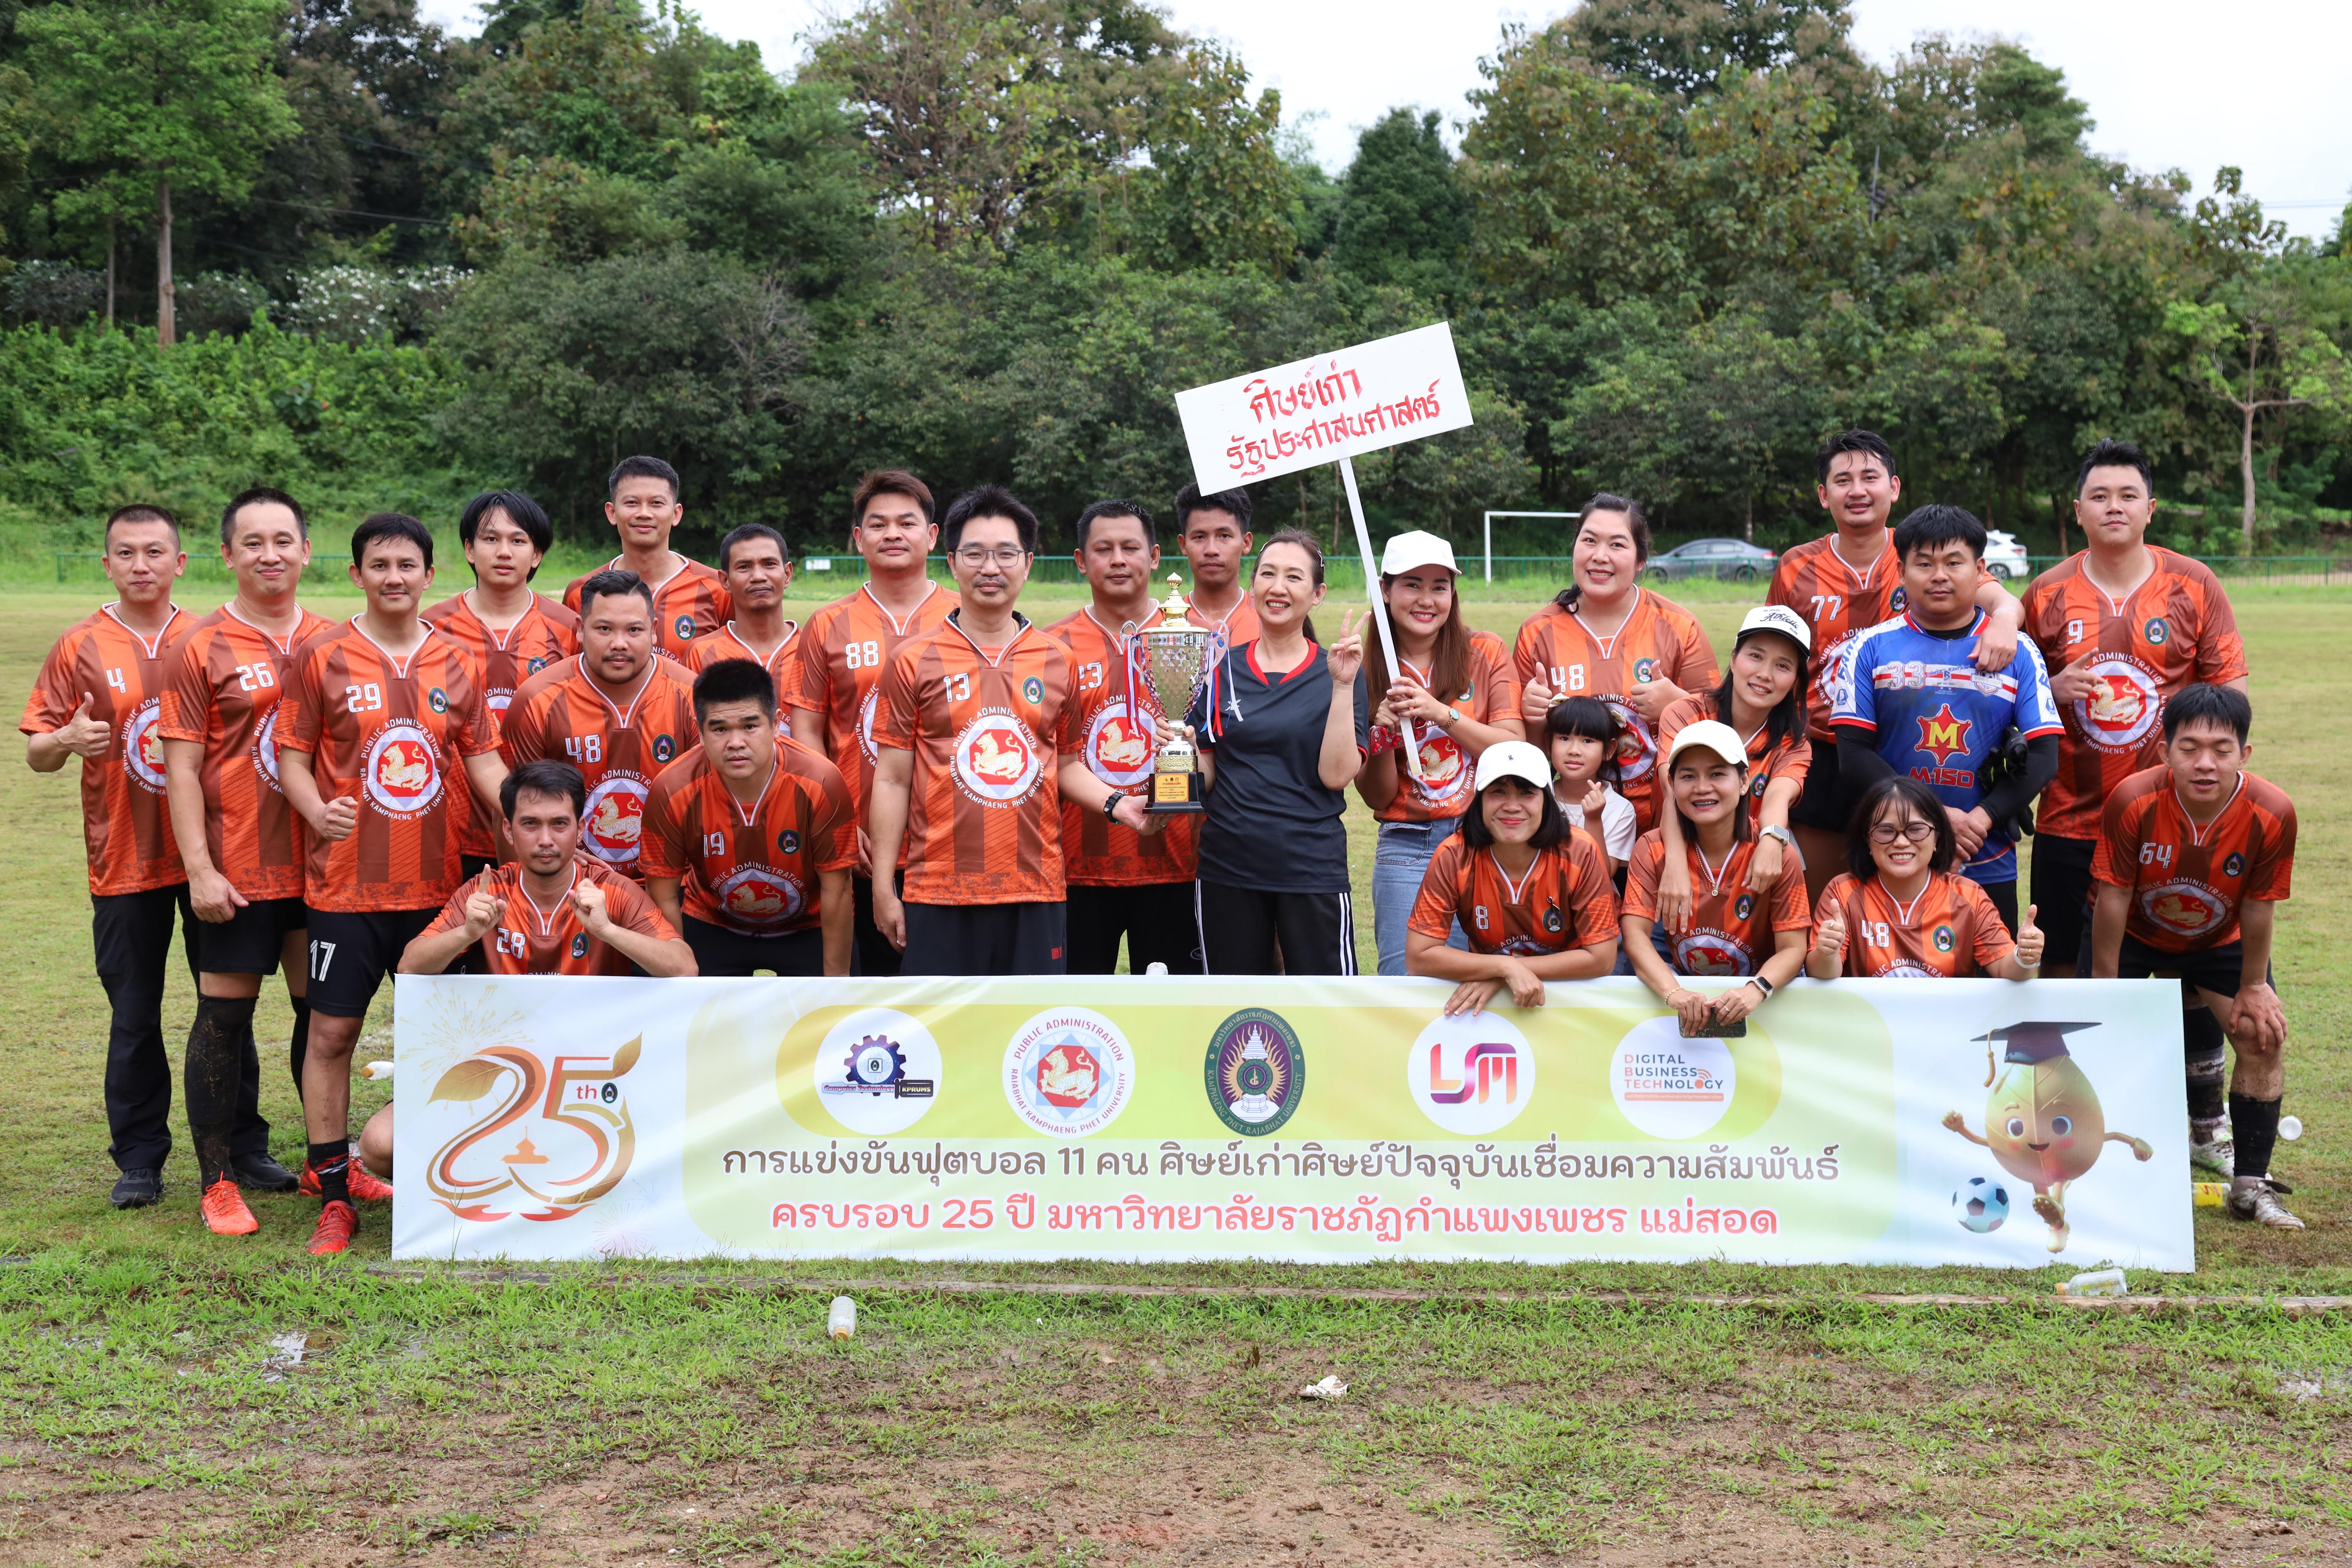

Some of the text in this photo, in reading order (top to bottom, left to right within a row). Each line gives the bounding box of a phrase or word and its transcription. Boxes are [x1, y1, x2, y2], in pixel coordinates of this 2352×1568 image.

[1243, 359, 1363, 424] ศิษย์เก่า
[1227, 377, 1441, 478] รัฐประศาสนศาสตร์
[1811, 595, 1842, 621] 77
[2067, 618, 2083, 645] 9
[845, 640, 879, 669] 88
[1819, 637, 1841, 664] PUBLIC
[106, 668, 127, 694] 4
[235, 662, 275, 692] 26
[943, 672, 971, 703] 13
[1550, 663, 1585, 692] 48
[1887, 661, 1926, 690] 33
[346, 682, 382, 713] 29
[859, 683, 879, 714] PUBLIC
[121, 709, 139, 740] PUBLIC
[952, 717, 976, 748] PUBLIC
[1082, 704, 1102, 735] PUBLIC
[361, 727, 384, 759] PUBLIC
[565, 733, 602, 764] 48
[1926, 721, 1961, 749] M
[2083, 736, 2125, 754] KAMPHAENG
[2129, 738, 2147, 752] PHET
[138, 778, 166, 795] KAMPHA
[601, 769, 652, 788] ADMINISTR
[949, 755, 965, 790] RAJABHAT
[963, 789, 1008, 808] KAMPHAENG
[1012, 795, 1027, 808] PHET
[1133, 782, 1150, 793] PHET
[1416, 795, 1449, 808] KAMPHAENG
[1451, 789, 1466, 803] PHET
[1463, 765, 1475, 789] UNIVER
[1909, 767, 1974, 789] M-150
[369, 799, 412, 820] KAMPHAENG
[415, 805, 431, 819] PHET
[703, 831, 725, 858] 19
[2139, 842, 2172, 868] 64
[710, 861, 804, 891] PUBLIC ADMINISTRATION
[2167, 877, 2234, 908] ADMINISTRATION
[1475, 905, 1489, 930] 8
[496, 927, 526, 960] 28
[1689, 926, 1753, 954] ADMINISTRATION
[1861, 919, 1890, 948] 48
[309, 940, 336, 982] 17
[1891, 958, 1947, 977] ADMINISTRA
[1014, 1018, 1124, 1061] PUBLIC ADMINISTRATION
[1625, 1054, 1685, 1064] DIGITAL
[1625, 1067, 1697, 1076] BUSINESS
[1011, 1068, 1125, 1134] RAJABHAT KAMPHAENG PHET UNIVERSITY
[1207, 1069, 1302, 1136] KAMPHAENG PHET RAJABHAT UNIVERSITY
[426, 1030, 643, 1205] 25 th
[723, 1133, 1840, 1190] การแข่งขันฟุตบอล 11 คน ศิษย์เก่าศิษย์ปัจจุบันเชื่อมความสัมพันธ์
[773, 1192, 1778, 1242] ครบรอบ 25 ปี มหาวิทยาลัยราชภัฏกำแพงเพชร แม่สอด
